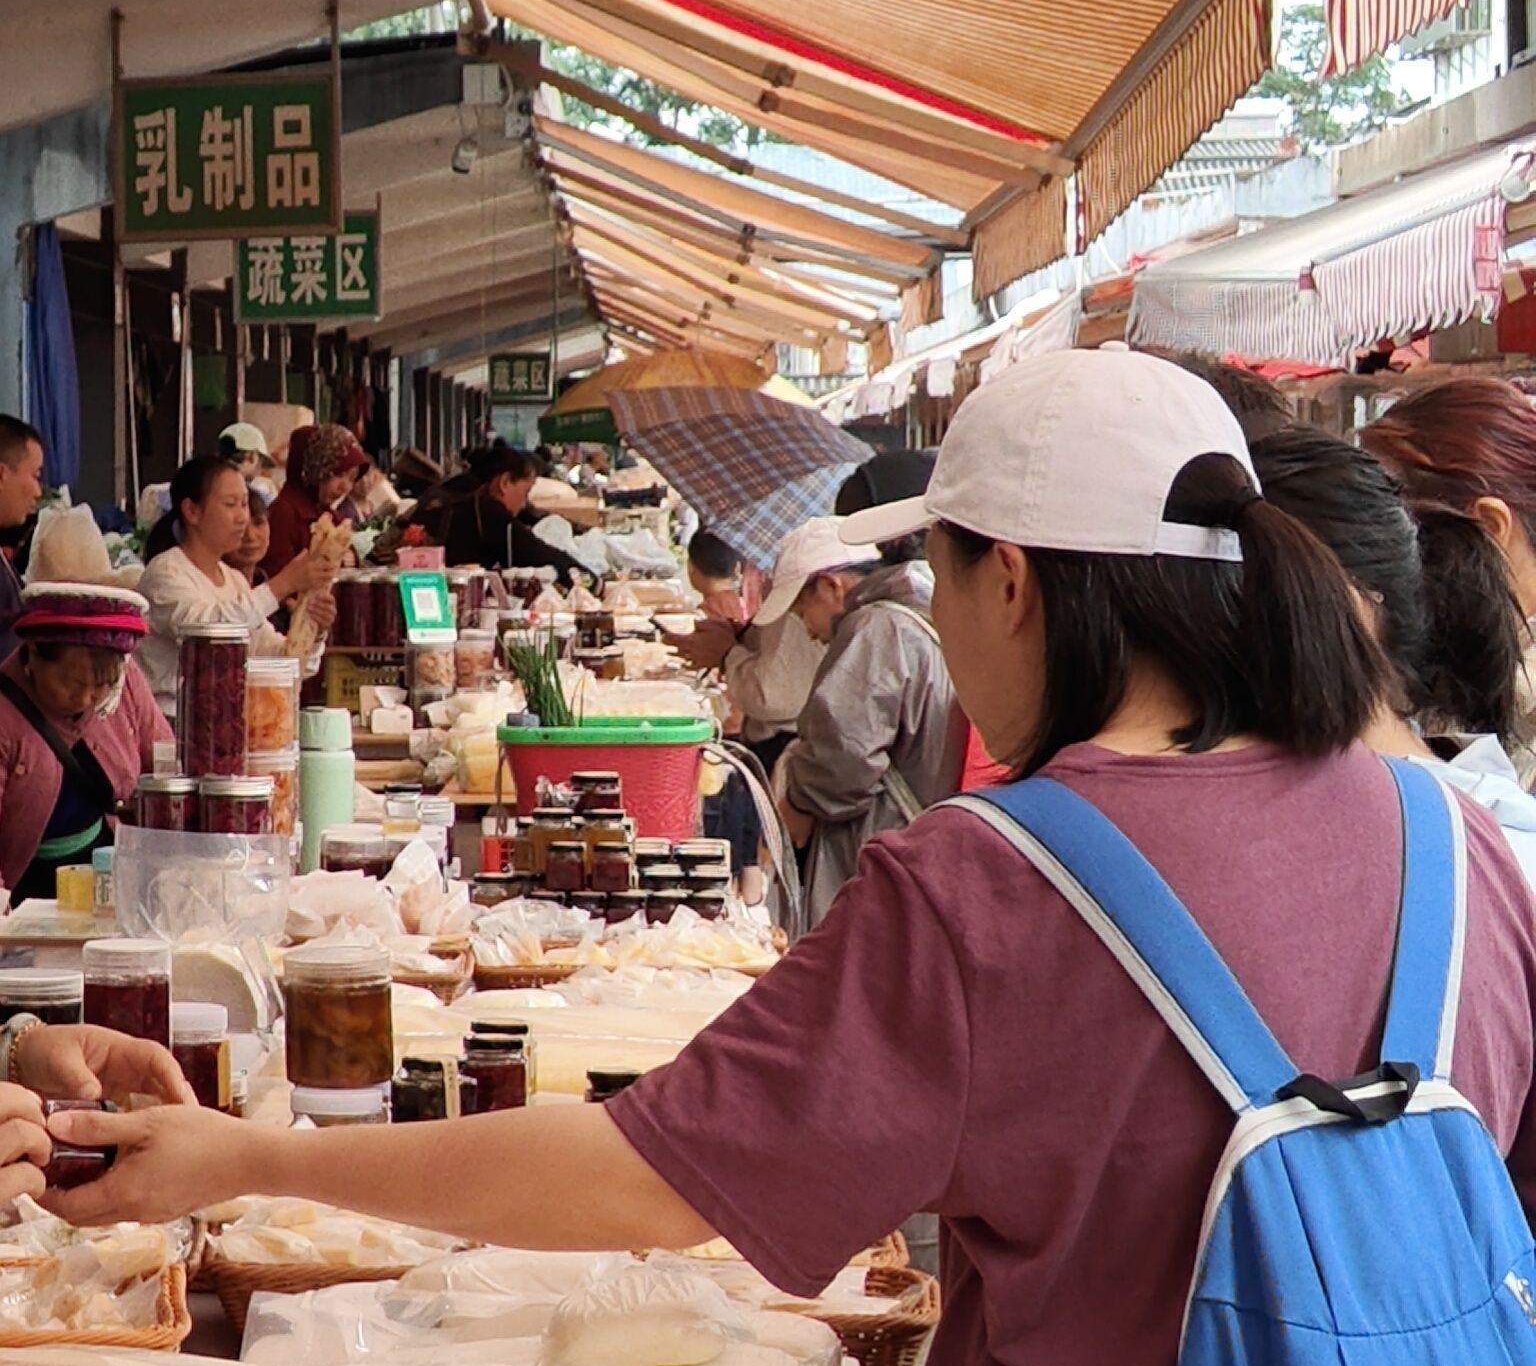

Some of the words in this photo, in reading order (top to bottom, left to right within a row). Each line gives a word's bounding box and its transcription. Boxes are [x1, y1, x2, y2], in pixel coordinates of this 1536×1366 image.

[133, 104, 320, 216] 乳制品
[246, 234, 370, 305] 蔬菜区
